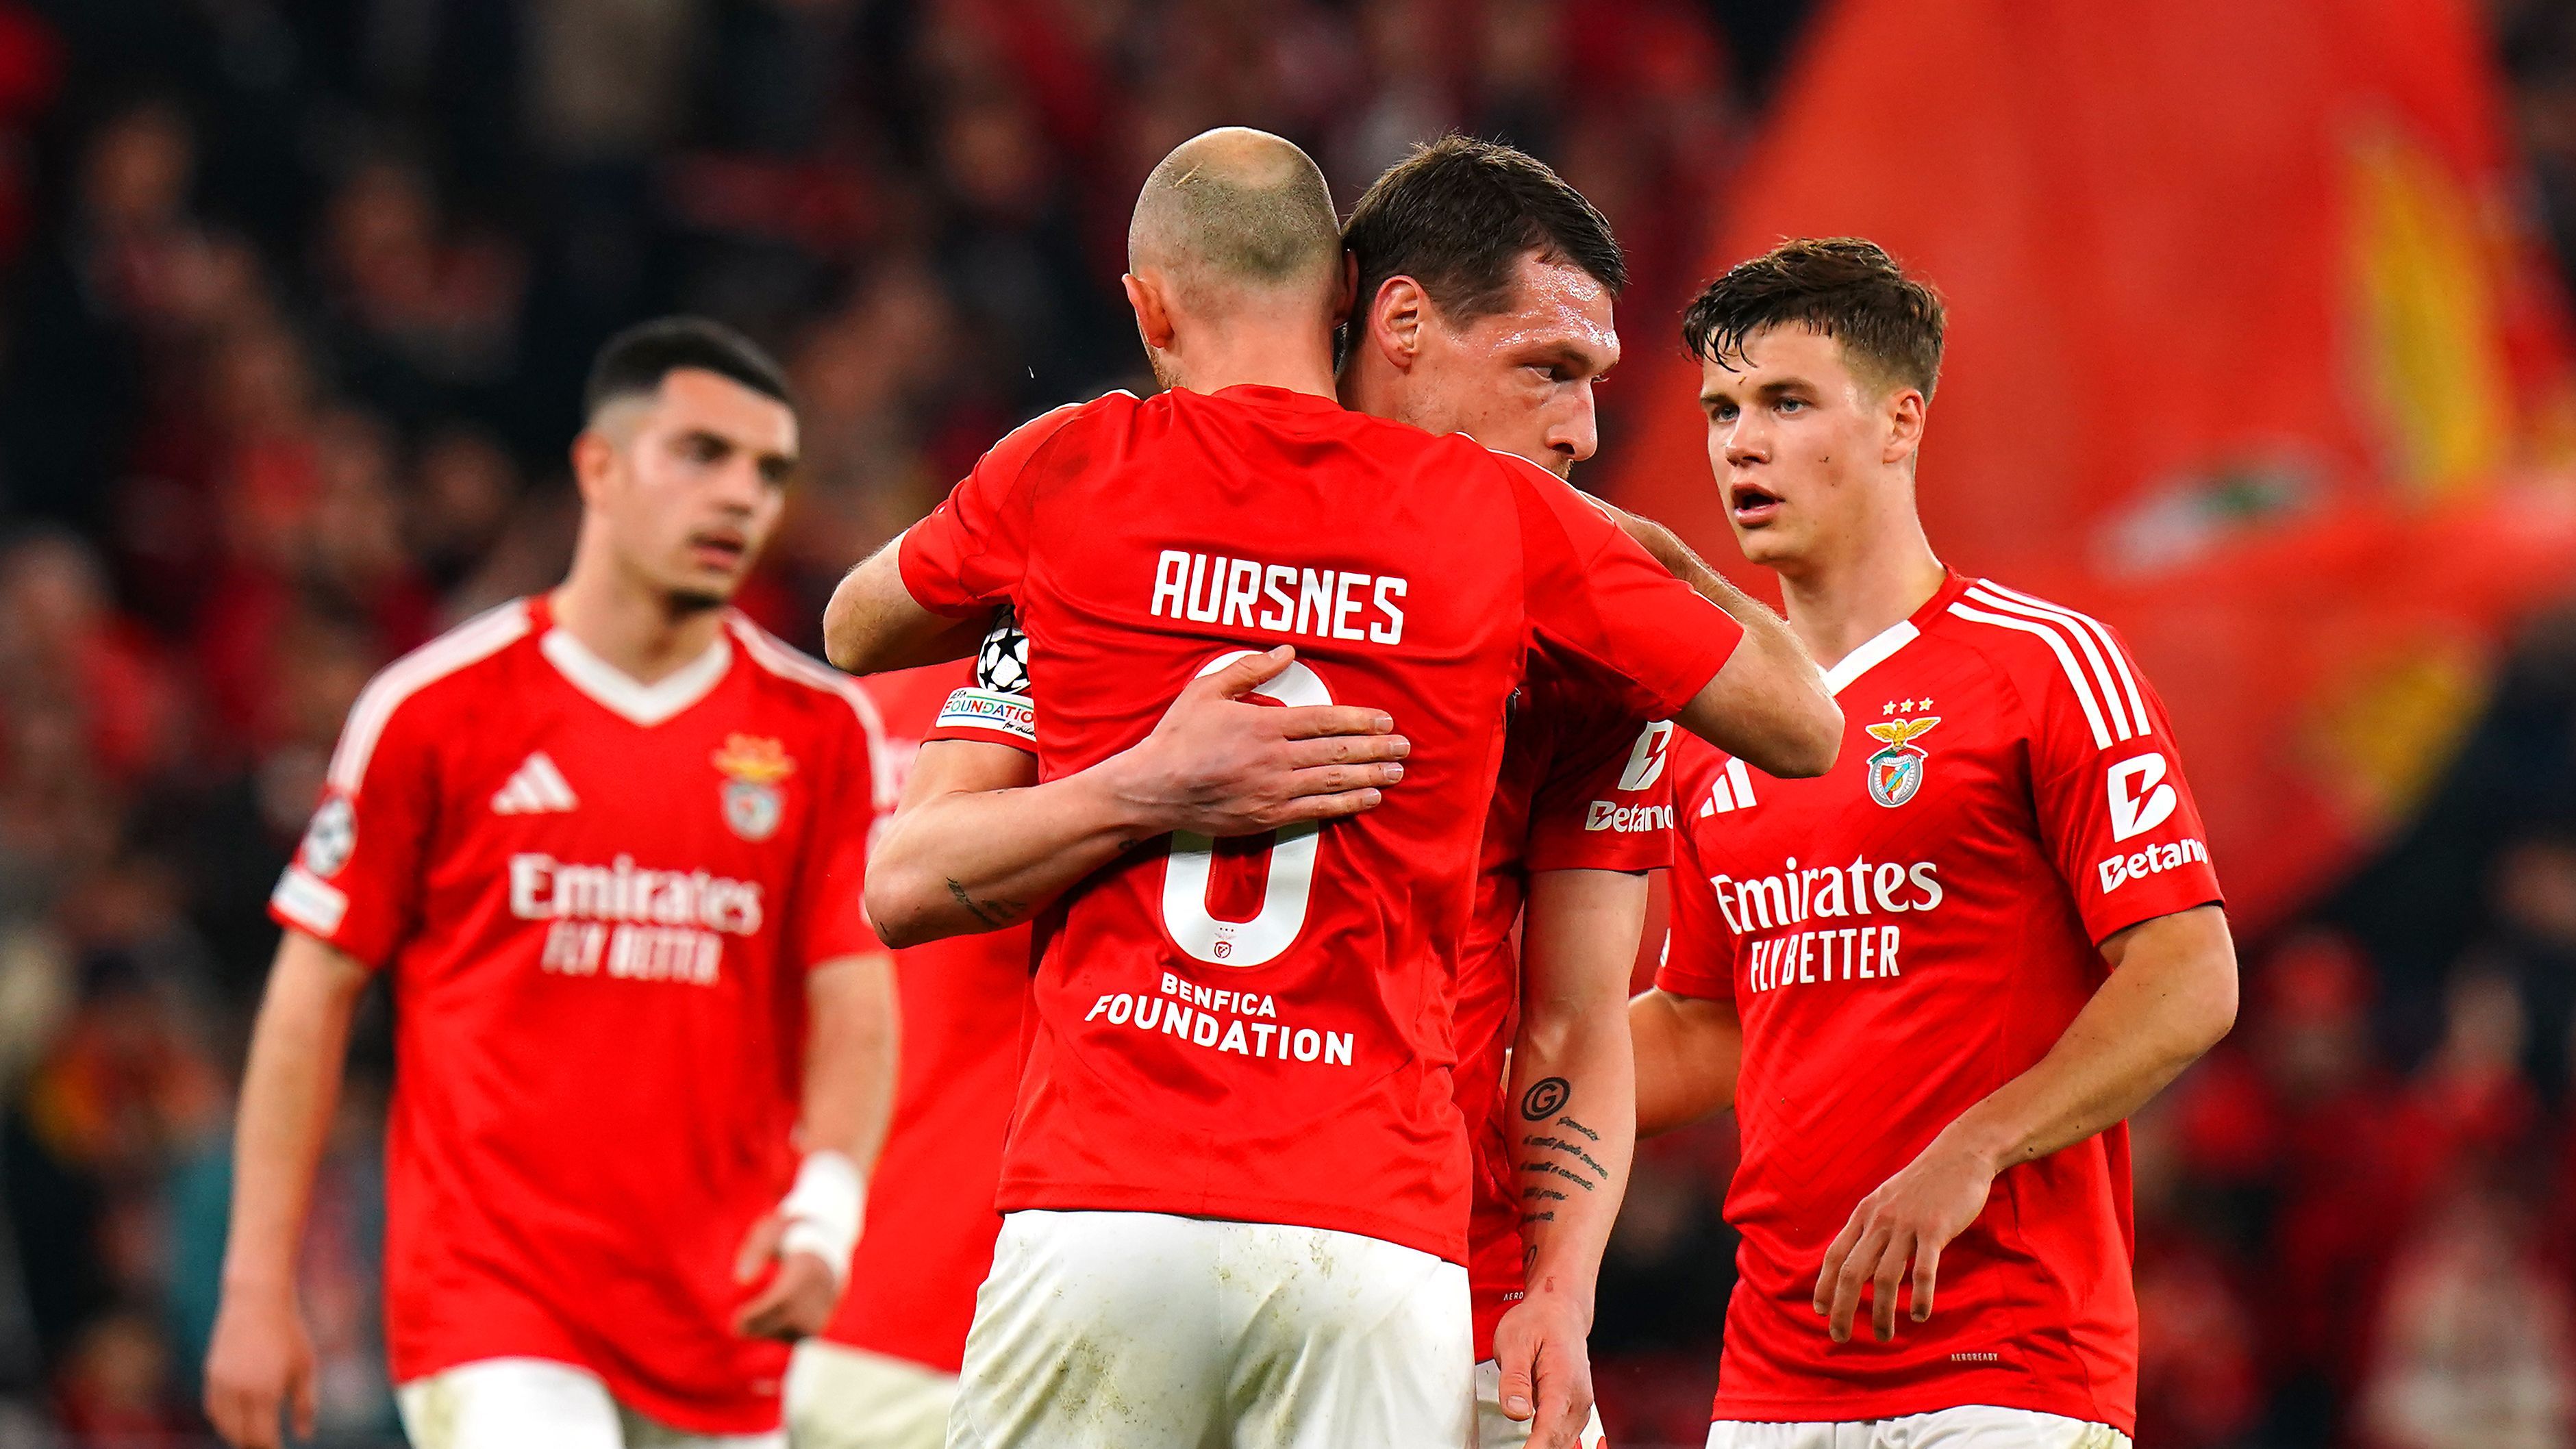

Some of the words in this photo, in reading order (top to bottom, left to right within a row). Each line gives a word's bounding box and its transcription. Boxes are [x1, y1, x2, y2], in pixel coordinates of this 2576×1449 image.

[1151, 550, 1408, 645] AURSNES
[943, 700, 1034, 723] FOUNDATIO
[508, 853, 764, 937] Emirates
[1710, 854, 1942, 935] Emirates
[2098, 838, 2208, 894] Betano
[1085, 993, 1354, 1066] FOUNDATION
[1161, 972, 1276, 1018] BENFICA
